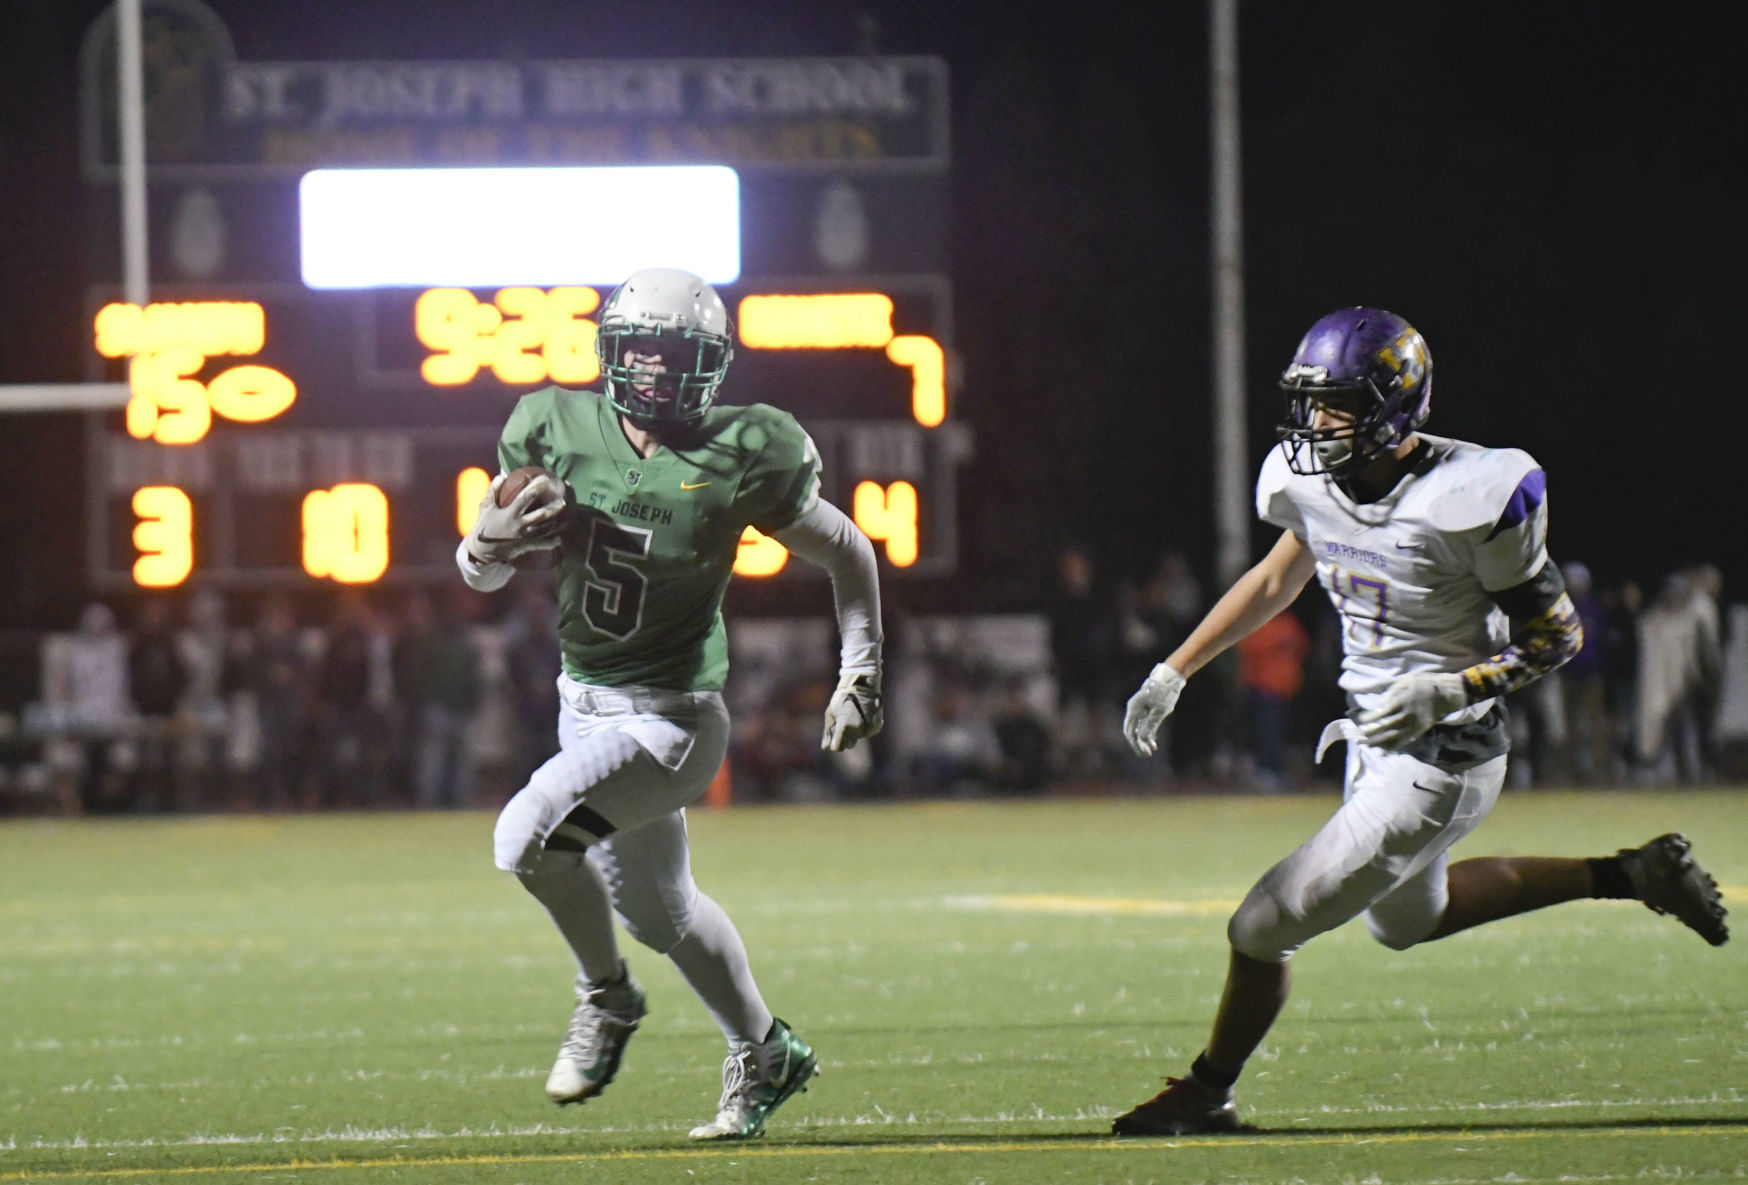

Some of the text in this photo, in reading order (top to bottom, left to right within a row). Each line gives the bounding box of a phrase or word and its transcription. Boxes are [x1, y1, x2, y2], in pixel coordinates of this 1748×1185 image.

[132, 485, 194, 588] 3
[302, 482, 390, 584] 10
[611, 499, 674, 526] JOSEPH
[854, 480, 919, 568] 4
[1324, 540, 1387, 567] WARRIORS
[582, 517, 653, 642] 5
[1330, 562, 1390, 650] 17
